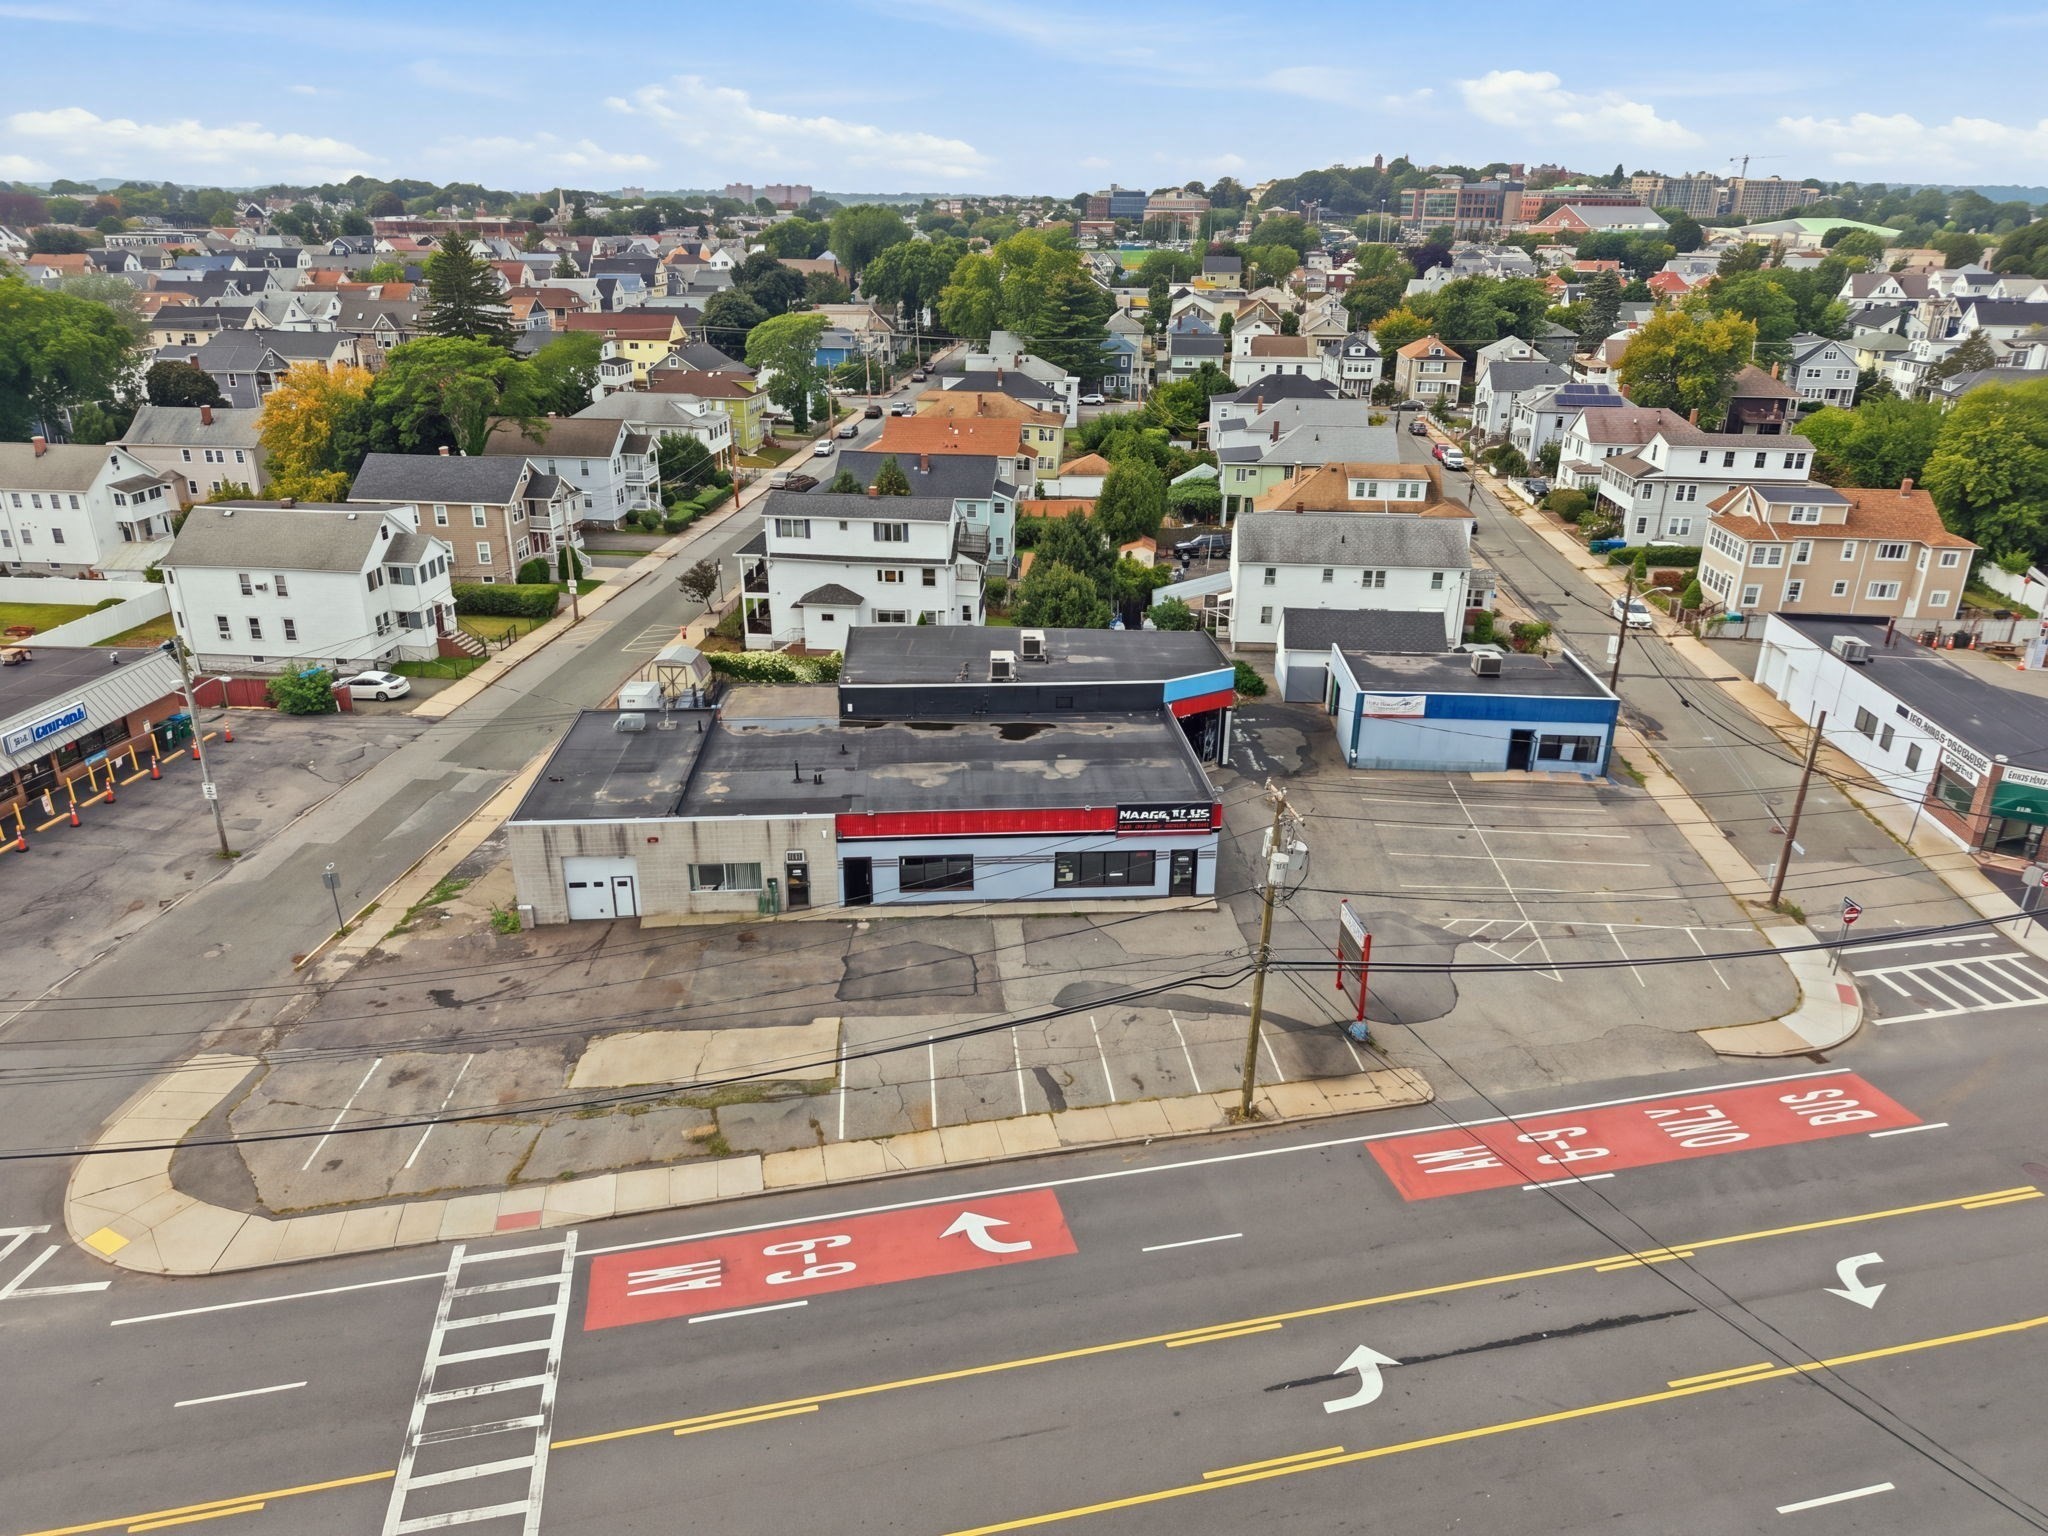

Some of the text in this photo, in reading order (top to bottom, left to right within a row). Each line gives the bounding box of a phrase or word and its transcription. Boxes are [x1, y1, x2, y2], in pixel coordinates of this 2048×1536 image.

[1644, 1104, 1750, 1148] ONLY
[1779, 1088, 1878, 1127] BUS
[1412, 1144, 1503, 1174] AM
[1516, 1126, 1610, 1165] 6-9
[627, 1259, 722, 1297] AM
[763, 1235, 857, 1285] 6-9
